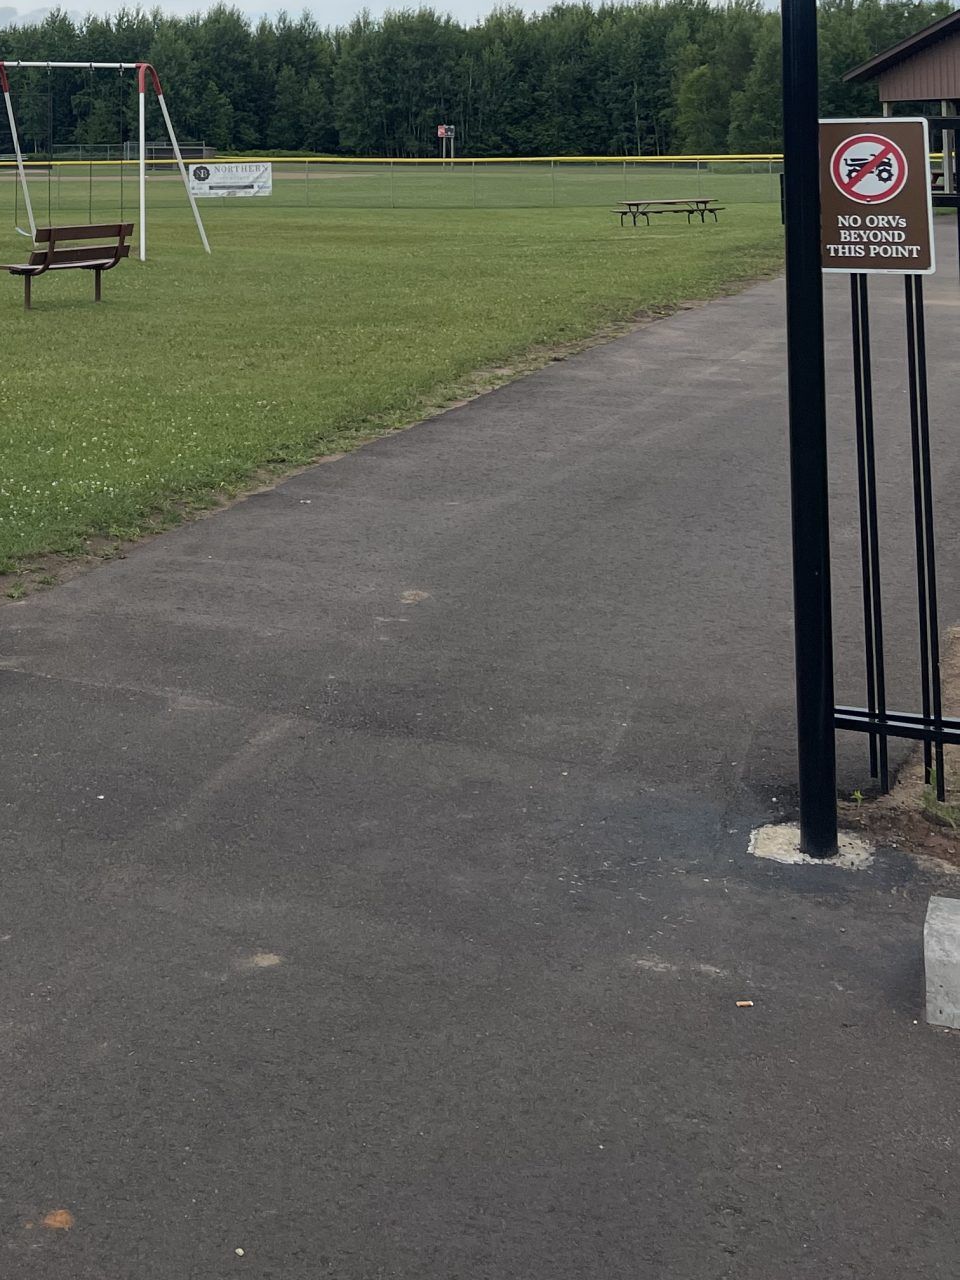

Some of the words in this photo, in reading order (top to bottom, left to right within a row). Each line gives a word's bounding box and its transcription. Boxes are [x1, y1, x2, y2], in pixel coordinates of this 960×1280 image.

[838, 215, 862, 227] NO
[866, 216, 907, 228] ORVs
[840, 230, 906, 243] BEYOND
[827, 245, 865, 257] THIS
[869, 246, 921, 258] POINT
